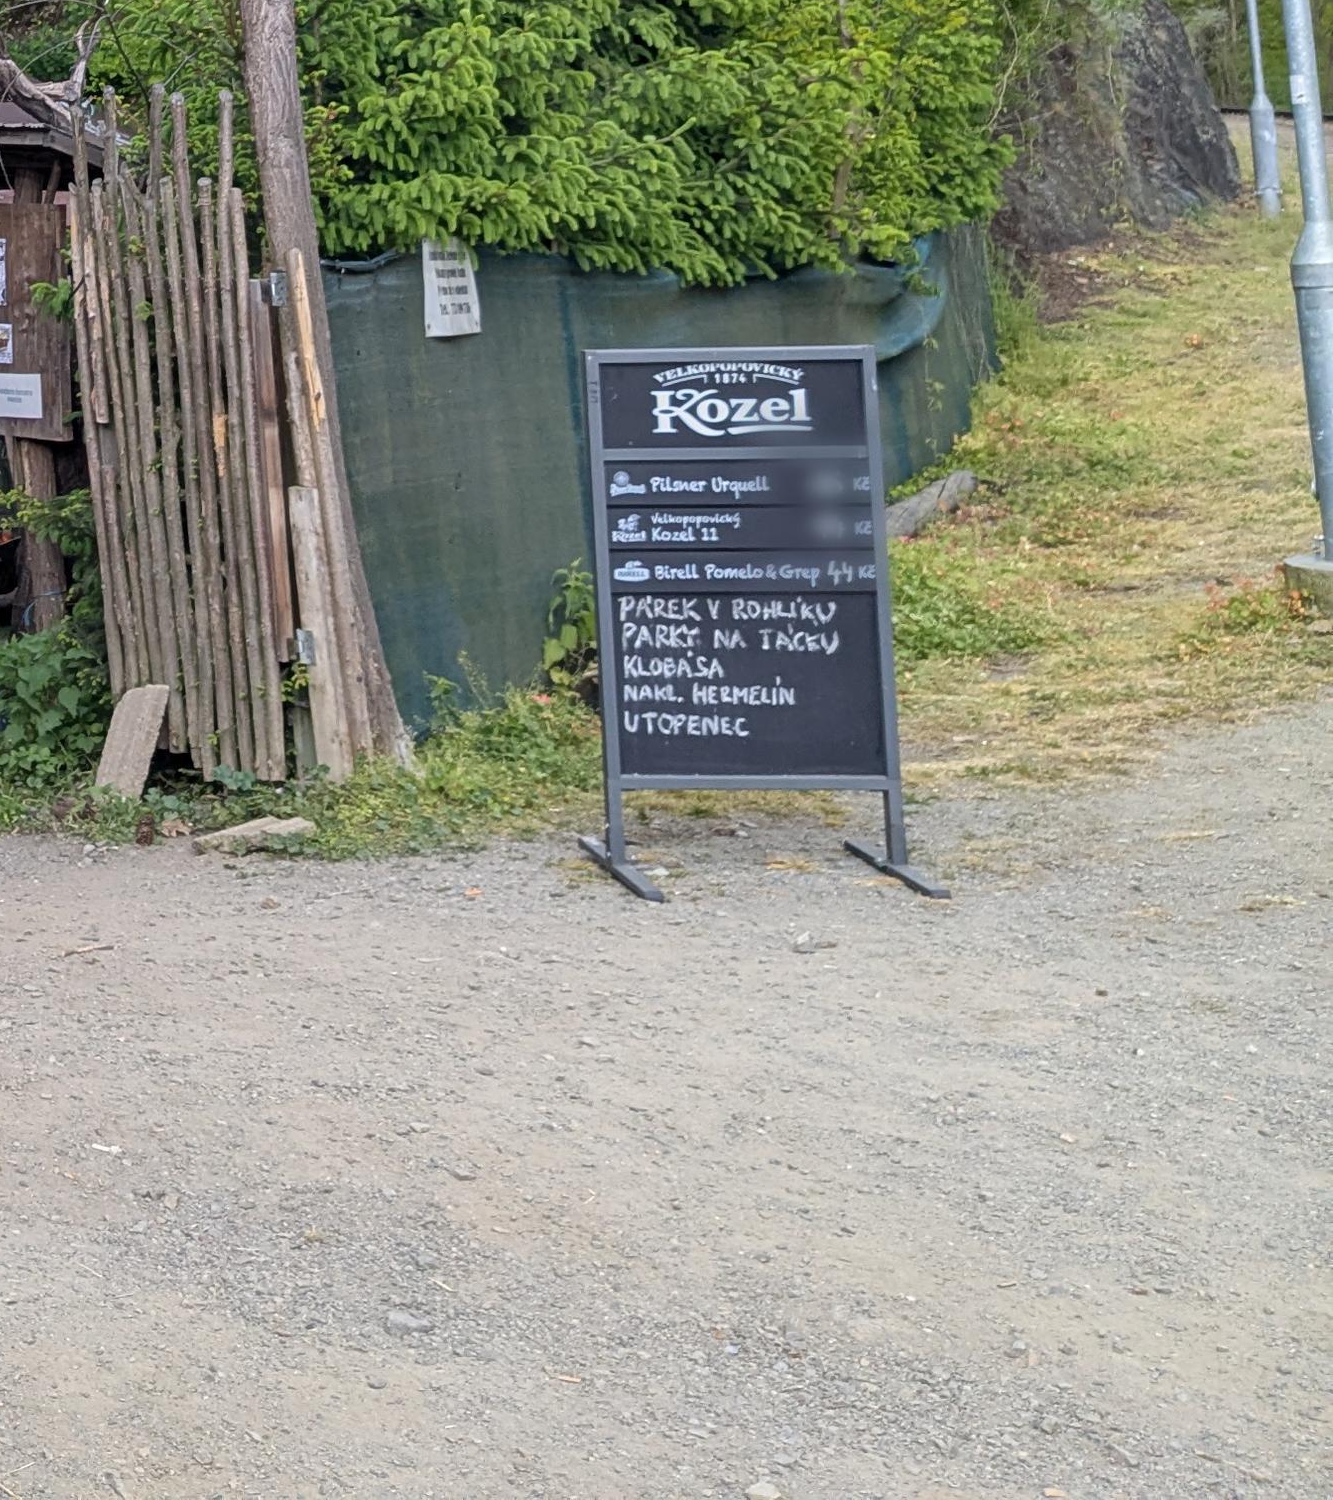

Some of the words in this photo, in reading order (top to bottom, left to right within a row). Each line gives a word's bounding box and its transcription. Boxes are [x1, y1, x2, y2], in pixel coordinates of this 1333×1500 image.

[652, 362, 805, 384] VELKOPOPOVICKÝ
[713, 373, 747, 384] 1874
[650, 388, 813, 436] Kozel
[650, 476, 708, 492] Pilsner
[711, 476, 770, 499] Urquell
[651, 512, 741, 529] Velkopopovický
[652, 526, 697, 541] Kozel
[700, 527, 719, 541] 11
[654, 563, 700, 580] Birell
[704, 563, 764, 580] Pomelo
[779, 563, 820, 588] Grep
[827, 560, 853, 586] 44
[617, 595, 702, 621] PÁREK
[707, 599, 721, 620] V
[732, 596, 837, 625] ROHLÍKU
[713, 629, 747, 649] NA
[623, 651, 725, 679] KLOBÁSA
[623, 683, 684, 703] NAKL.
[693, 676, 796, 705] HERMELÍN
[623, 710, 750, 737] UTOPENEC
